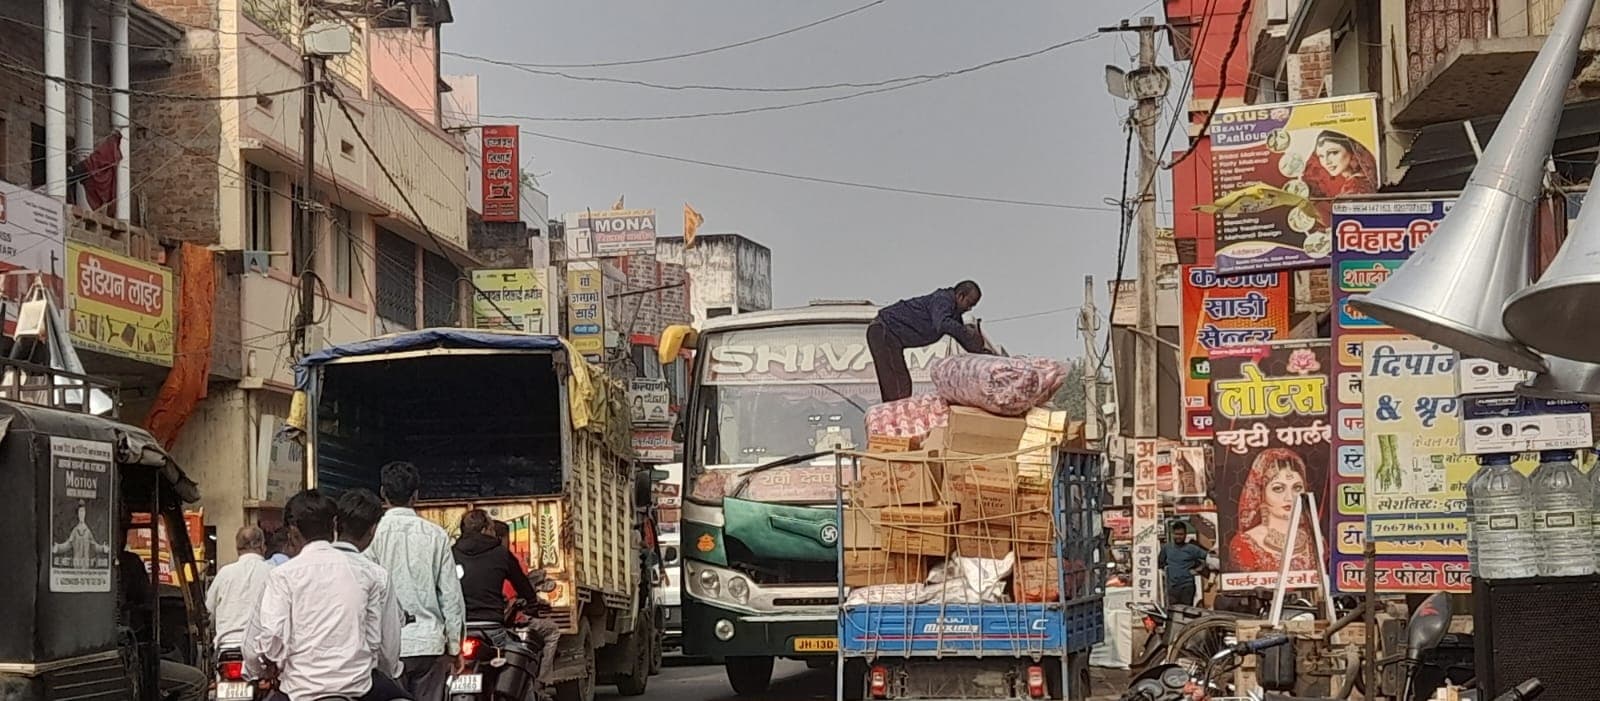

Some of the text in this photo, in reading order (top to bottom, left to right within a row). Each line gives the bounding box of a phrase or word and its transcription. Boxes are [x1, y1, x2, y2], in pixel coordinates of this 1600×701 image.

[595, 217, 654, 232] MONA
[1337, 221, 1406, 253] विहार
[1204, 293, 1267, 321] साड़ी
[1216, 364, 1327, 416] लोटस
[1376, 395, 1402, 420] &
[1393, 562, 1441, 586] फोटो
